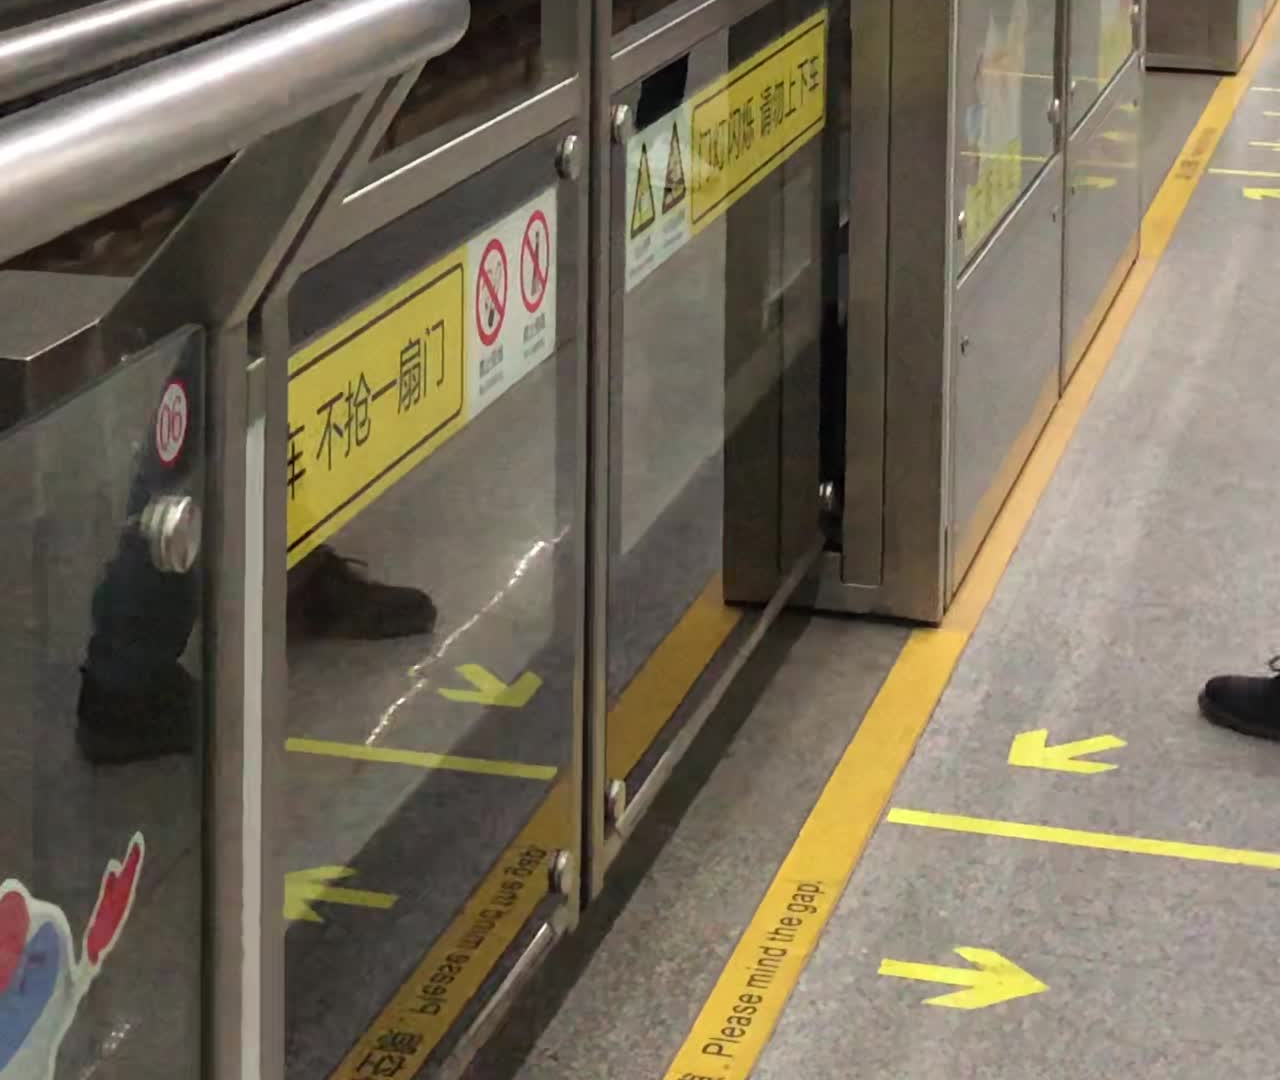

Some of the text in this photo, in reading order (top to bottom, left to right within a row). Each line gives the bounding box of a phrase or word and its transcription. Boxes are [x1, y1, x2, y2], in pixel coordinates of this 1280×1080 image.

[160, 394, 183, 453] 06
[316, 318, 445, 471] 不抢一扇门
[766, 916, 803, 943] the
[746, 946, 788, 990] mind
[701, 993, 763, 1058] Please
